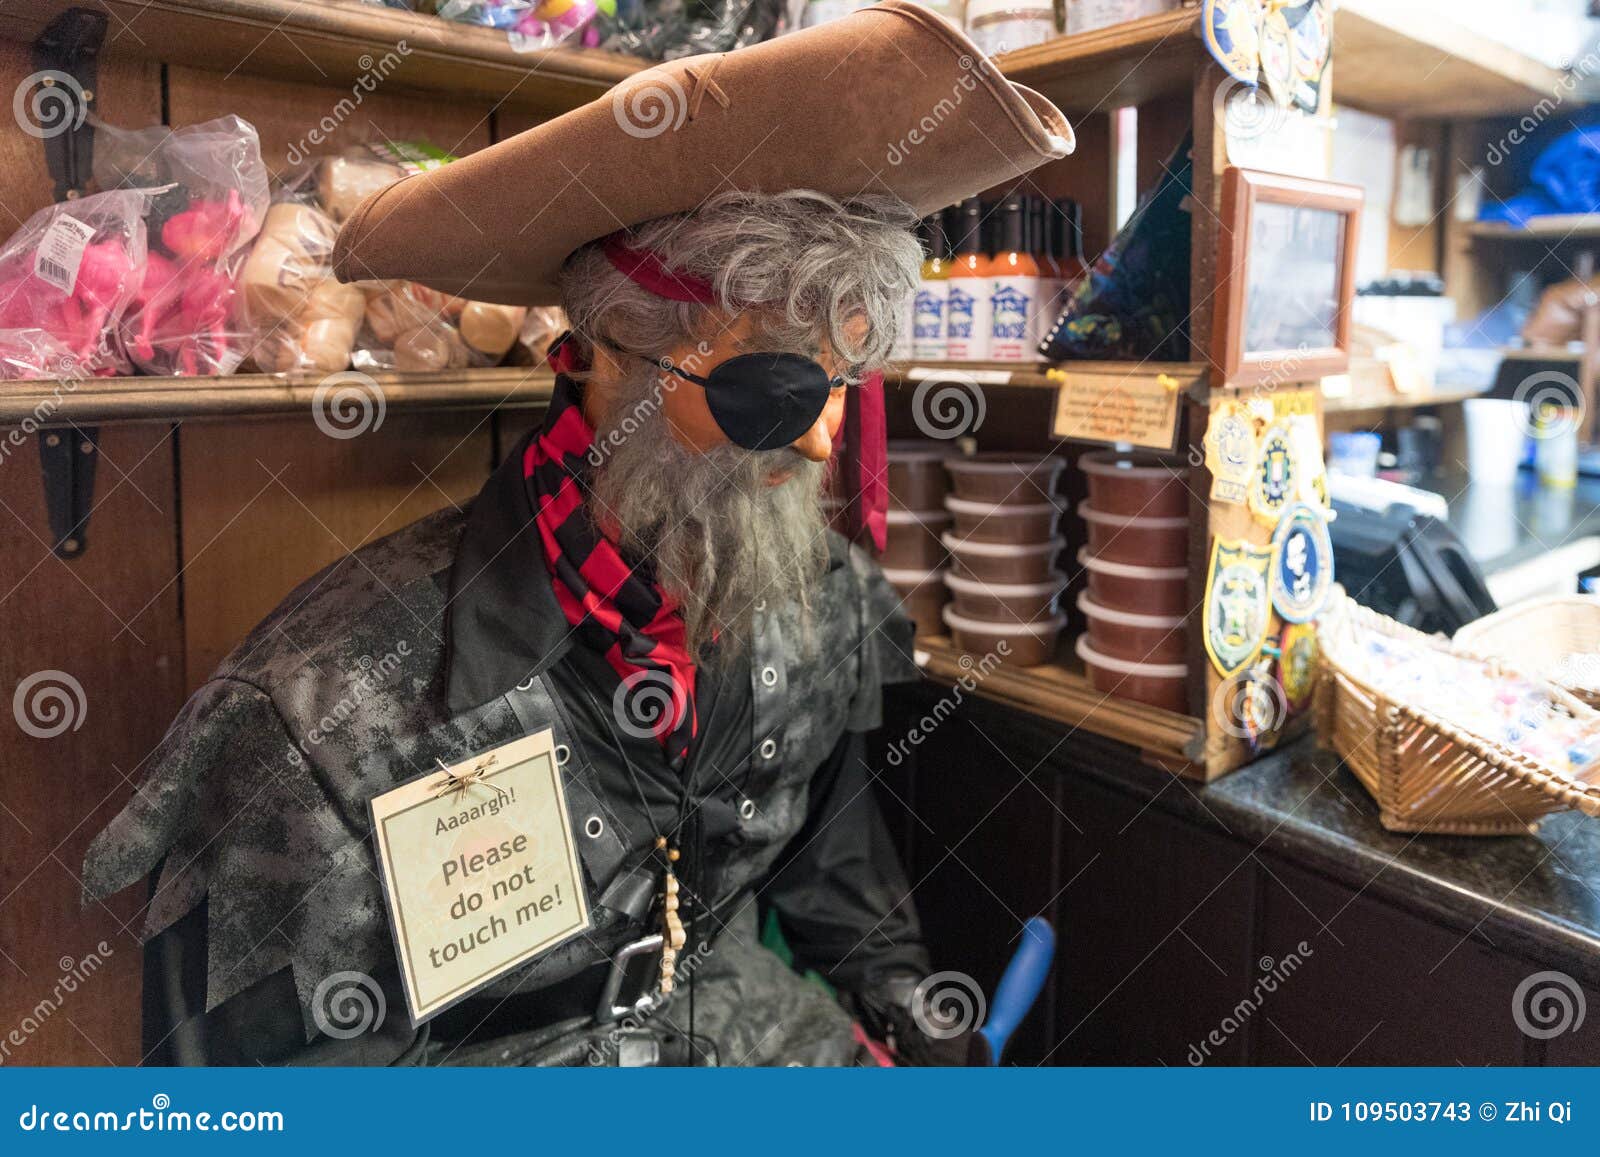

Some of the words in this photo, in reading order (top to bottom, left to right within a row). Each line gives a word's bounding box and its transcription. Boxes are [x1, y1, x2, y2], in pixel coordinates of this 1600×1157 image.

[435, 787, 516, 836] Aaaargh!
[442, 834, 528, 887] Please
[450, 888, 484, 920] do
[492, 864, 536, 901] not
[428, 915, 508, 969] touch
[515, 884, 563, 926] me!
